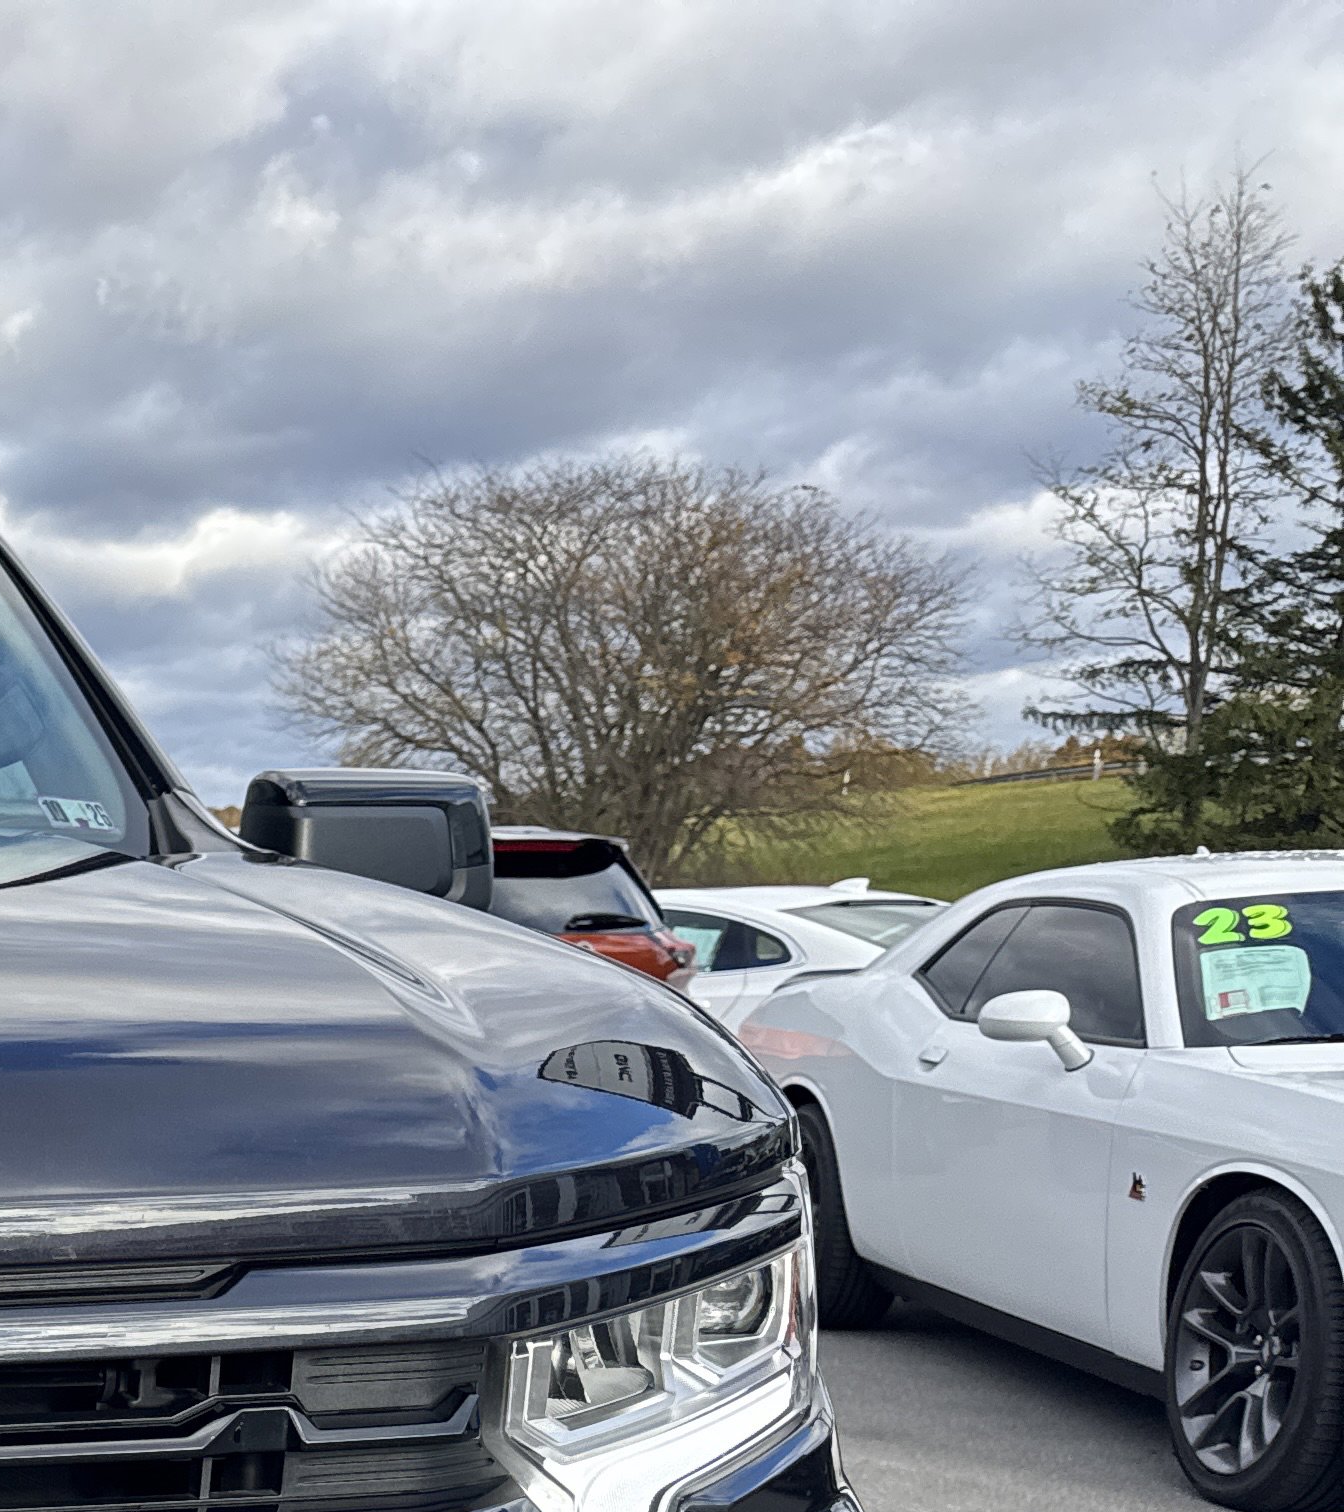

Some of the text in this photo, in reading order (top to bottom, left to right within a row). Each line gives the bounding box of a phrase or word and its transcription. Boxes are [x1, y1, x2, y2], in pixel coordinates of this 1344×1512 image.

[42, 799, 113, 827] 10 26
[1192, 904, 1293, 945] 23
